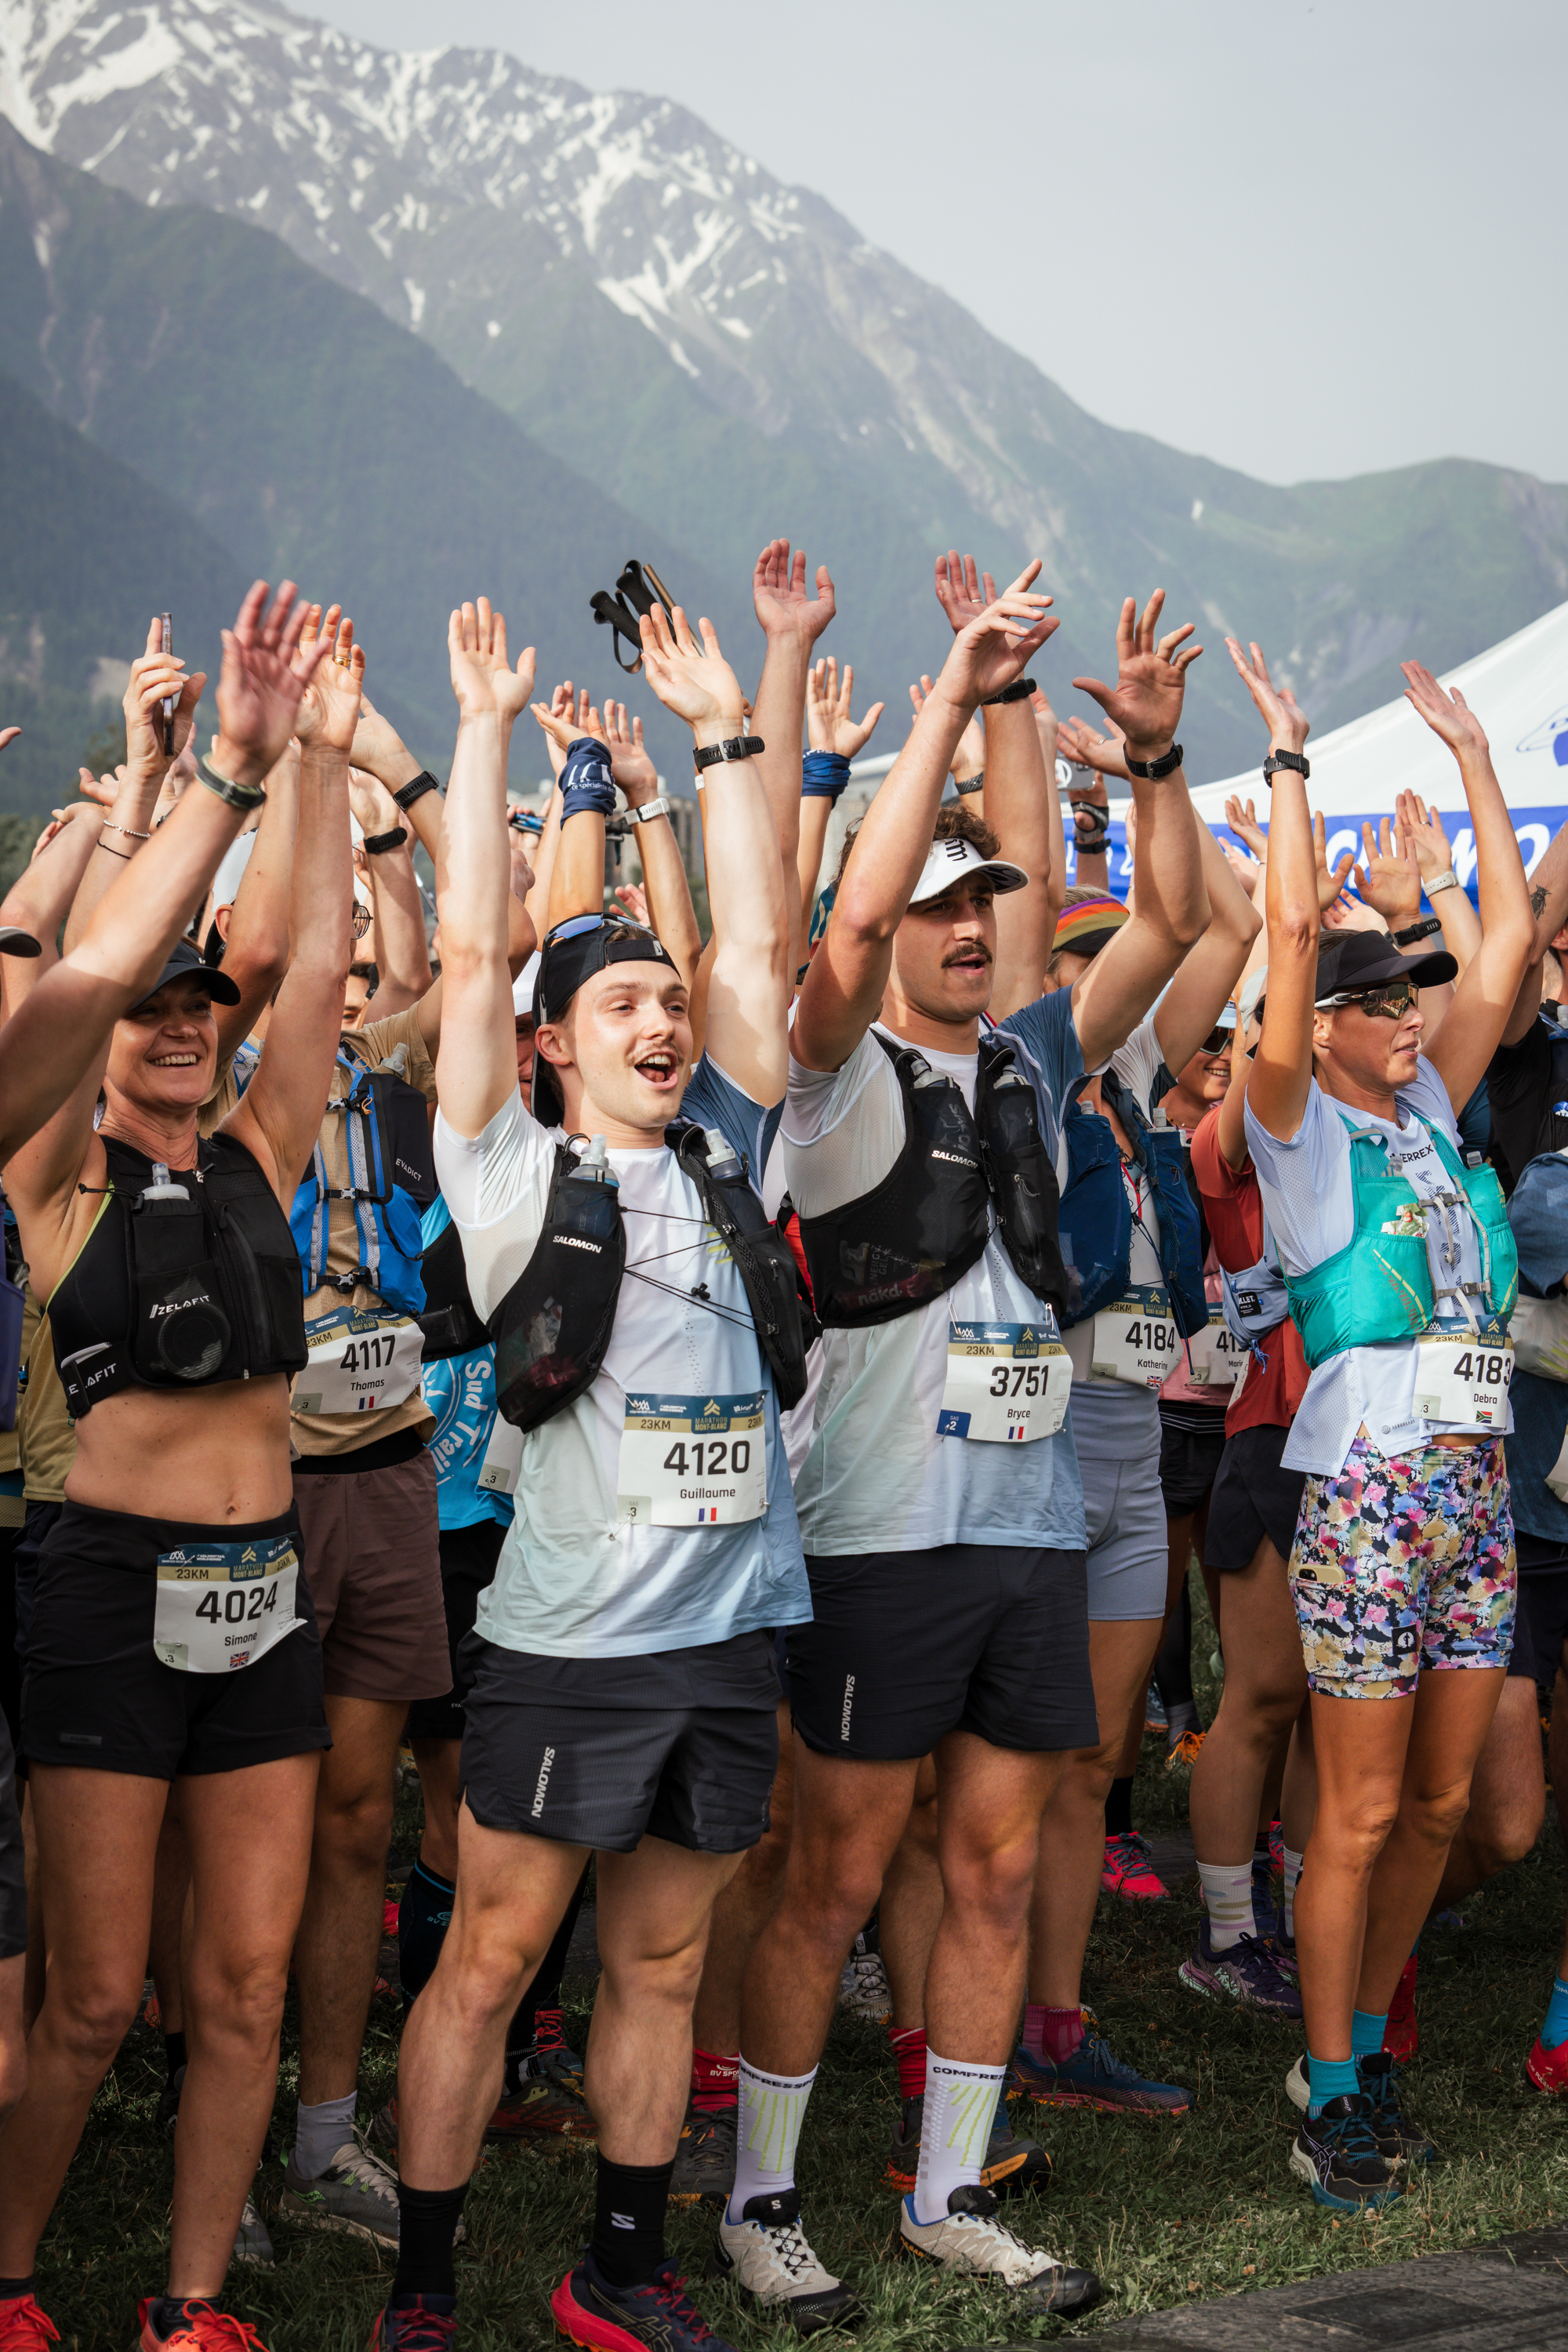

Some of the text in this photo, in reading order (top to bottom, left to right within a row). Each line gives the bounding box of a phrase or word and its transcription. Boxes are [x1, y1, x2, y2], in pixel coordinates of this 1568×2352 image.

[931, 1149, 978, 1169] SALOMON
[395, 1158, 422, 1181] EVADICT
[553, 1235, 602, 1254] SALOMON
[157, 1295, 209, 1316] ZELAFIT
[350, 1317, 375, 1327] MARATHON
[352, 1322, 376, 1331] MONT-BLANC
[307, 1332, 332, 1347] 23KM
[1125, 1322, 1174, 1353] 4184
[340, 1334, 395, 1372] 4117
[967, 1346, 994, 1355] 23KM
[1138, 1359, 1167, 1370] Katherine
[1454, 1352, 1511, 1386] 4183
[350, 1379, 384, 1392] Thomas
[463, 1360, 492, 1411] Sud
[989, 1365, 1049, 1397] 3751
[1474, 1394, 1497, 1404] Debra
[1007, 1409, 1030, 1420] Bryce
[641, 1419, 670, 1430] 23KM
[949, 1421, 956, 1430] 2
[431, 1421, 481, 1474] Trail
[663, 1440, 750, 1475] 4120
[680, 1488, 735, 1499] Guillaume
[630, 1508, 637, 1516] 3
[177, 1570, 209, 1579] 23KM
[234, 1563, 263, 1572] MARATHON
[234, 1570, 262, 1578] MONT-BLANC
[196, 1581, 278, 1624] 4024
[225, 1632, 257, 1646] Simone
[840, 1674, 855, 1741] SALOMON
[531, 1747, 555, 1818] SALOMON
